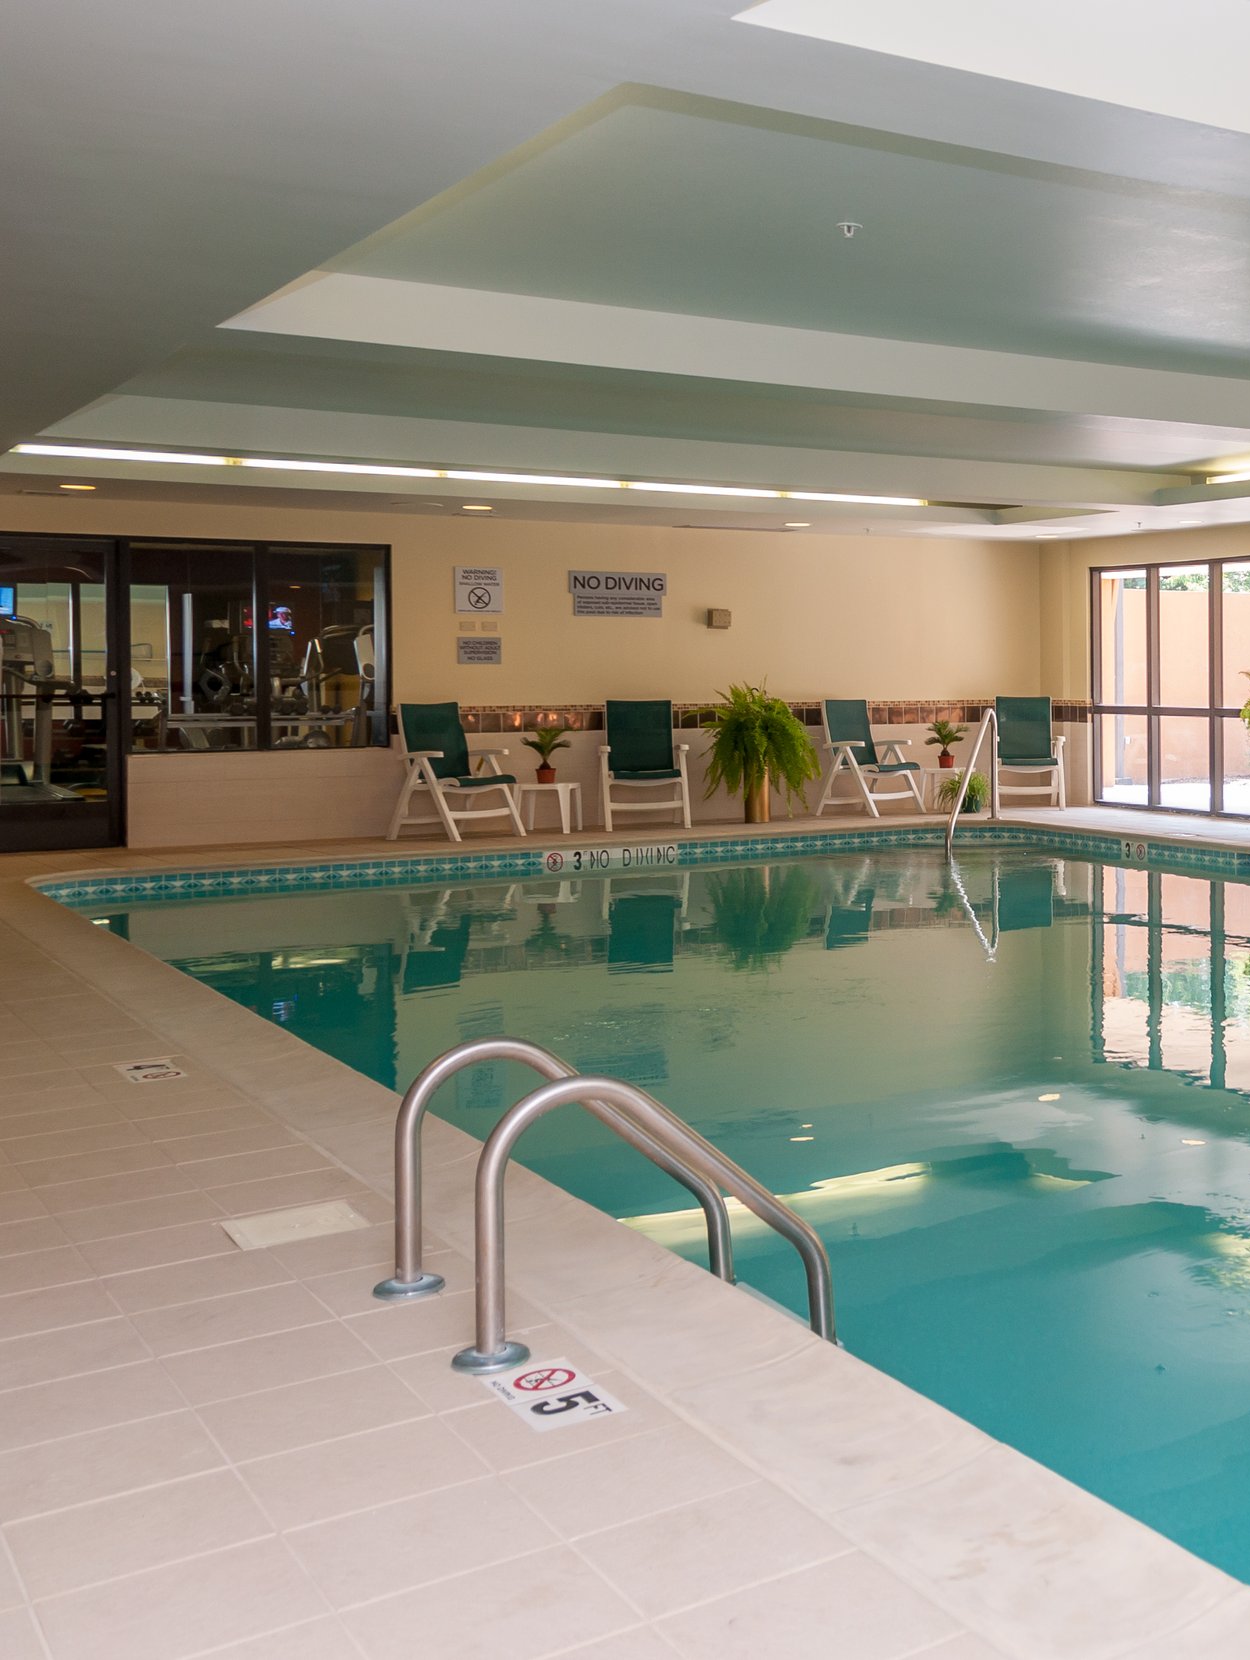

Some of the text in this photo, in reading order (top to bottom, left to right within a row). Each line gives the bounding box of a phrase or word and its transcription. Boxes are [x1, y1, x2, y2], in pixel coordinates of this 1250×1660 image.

[573, 575, 664, 591] NO DIVING
[1125, 843, 1131, 858] 3
[573, 851, 582, 870] 3
[530, 1390, 613, 1415] 5 FT
